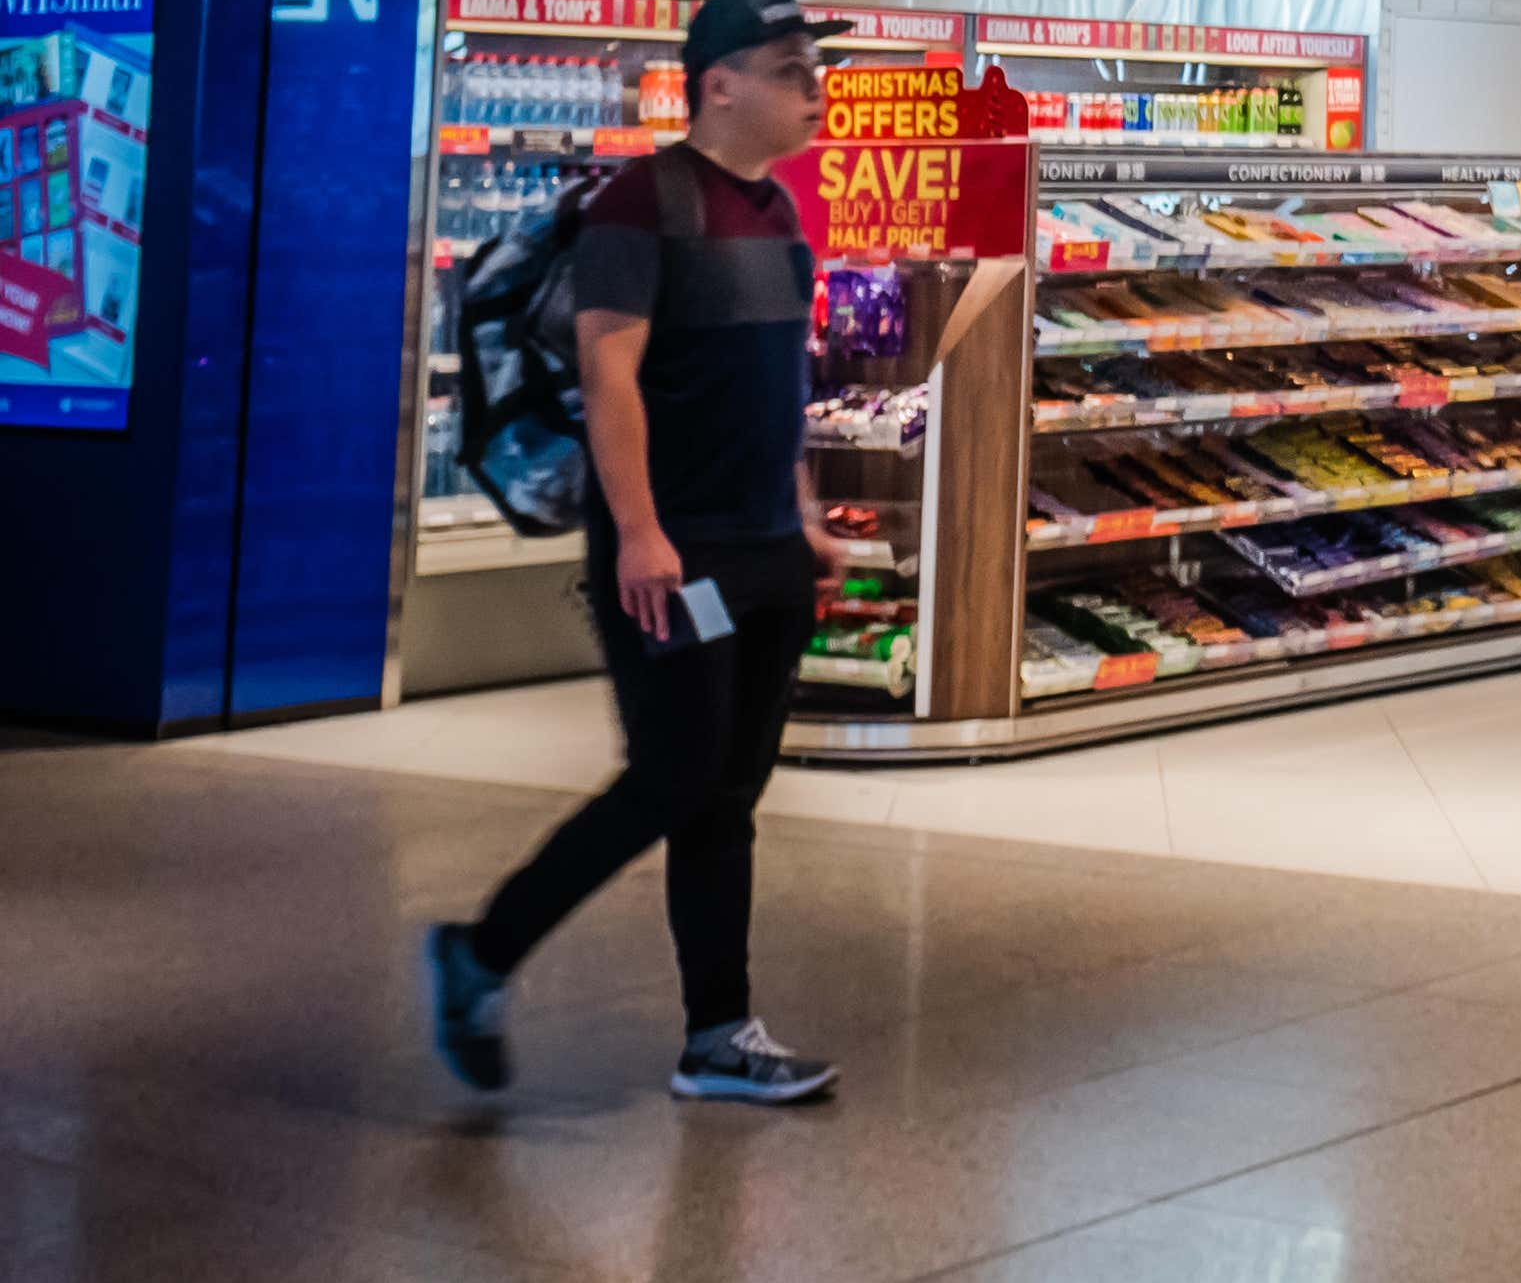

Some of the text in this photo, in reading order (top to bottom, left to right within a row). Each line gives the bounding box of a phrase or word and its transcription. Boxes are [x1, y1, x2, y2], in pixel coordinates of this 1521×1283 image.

[880, 16, 954, 40] YOURSELF
[1048, 21, 1091, 45] TOM'S
[1226, 31, 1258, 53] LOOK
[827, 70, 959, 98] CHRISTMAS
[827, 101, 959, 138] OFFERS
[817, 148, 961, 200] SAVE!
[1228, 164, 1350, 182] CONFECTIONERY
[829, 200, 948, 223] BUY 1 GET 1
[828, 227, 945, 249] HALF PRICE
